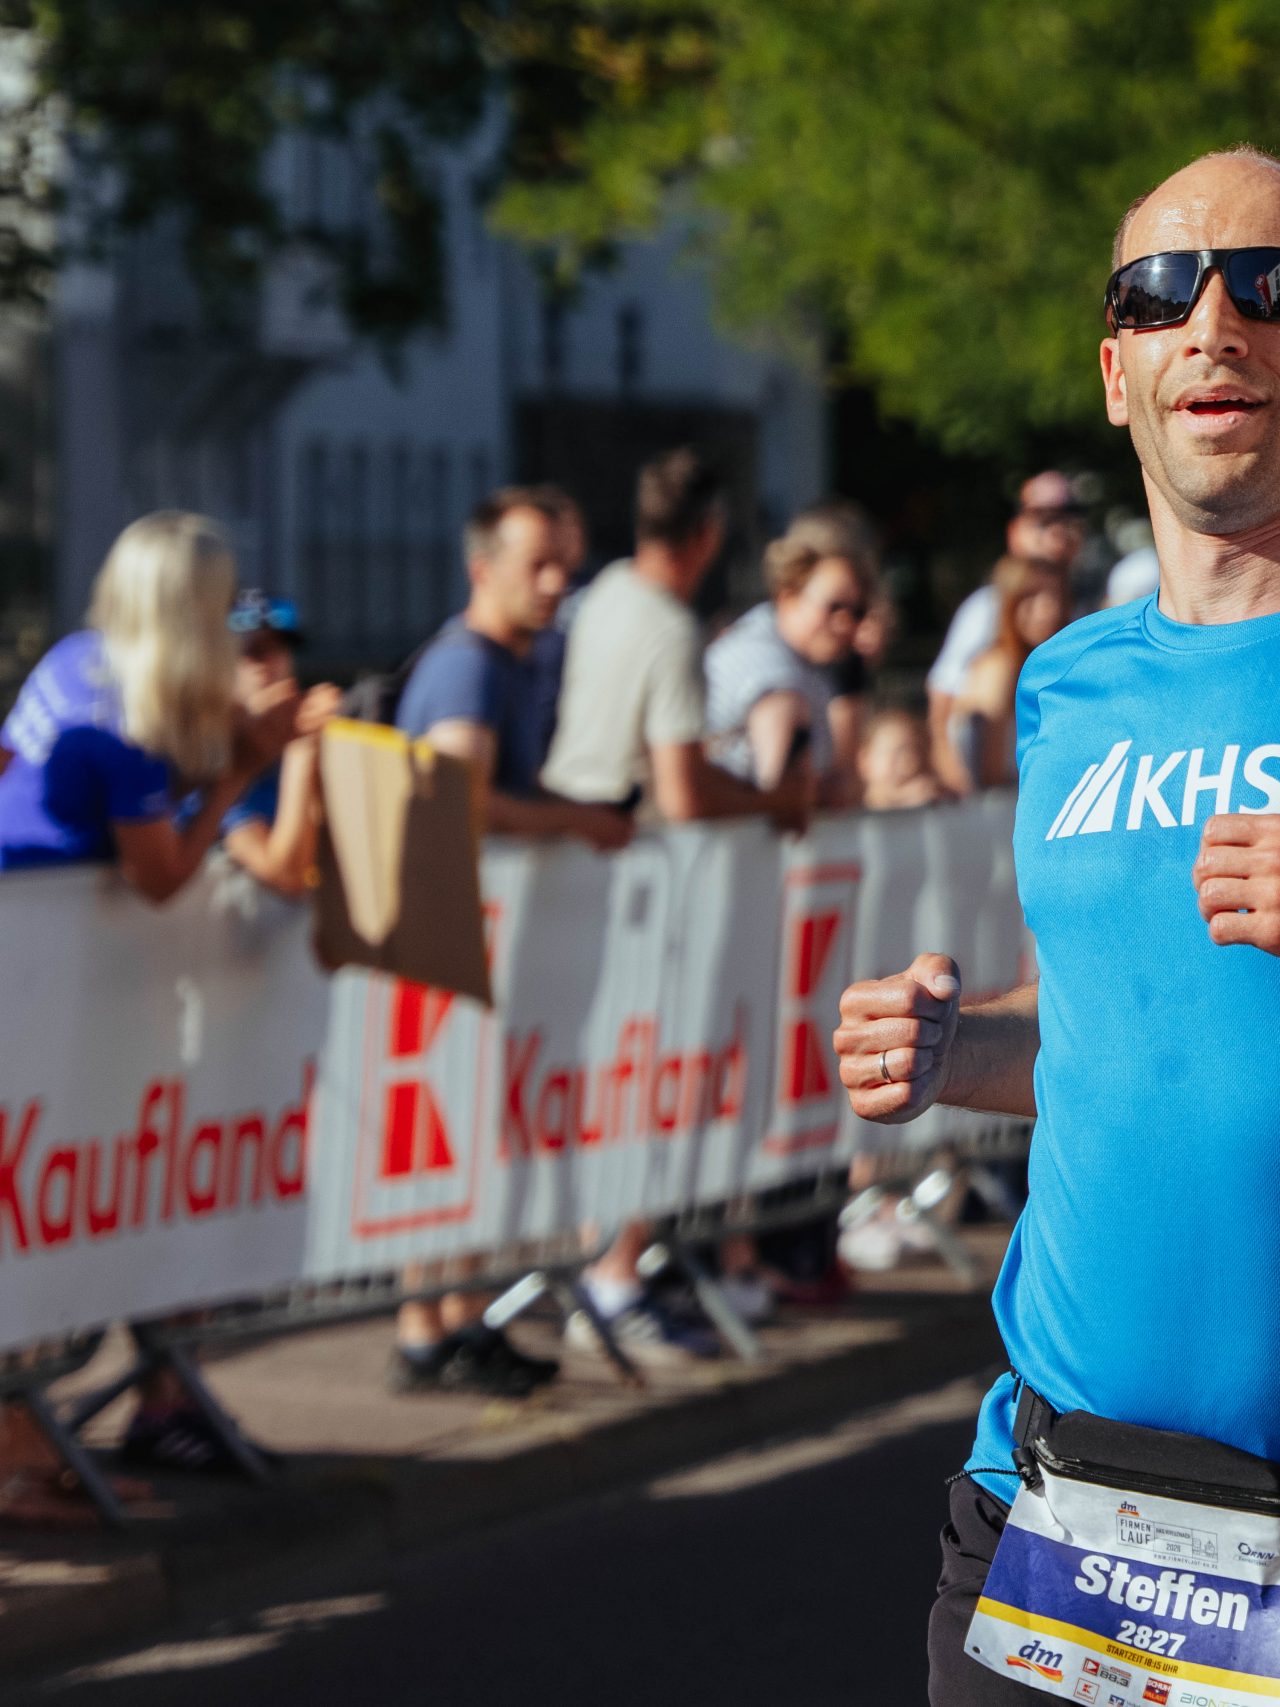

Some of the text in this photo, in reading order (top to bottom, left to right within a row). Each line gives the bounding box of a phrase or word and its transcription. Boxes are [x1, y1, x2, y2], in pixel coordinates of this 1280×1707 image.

[500, 998, 746, 1163] Kaufland
[0, 1058, 316, 1256] Kaufland
[1120, 1501, 1137, 1512] dm
[1120, 1519, 1151, 1532] FIRMEN
[1120, 1529, 1151, 1545] LAUF
[1074, 1554, 1249, 1632] Steffen
[1116, 1620, 1186, 1657] 2827
[1018, 1640, 1063, 1668] dm
[1106, 1644, 1179, 1674] STARTZEIT 18:15 UHR
[1099, 1671, 1129, 1687] 88.3
